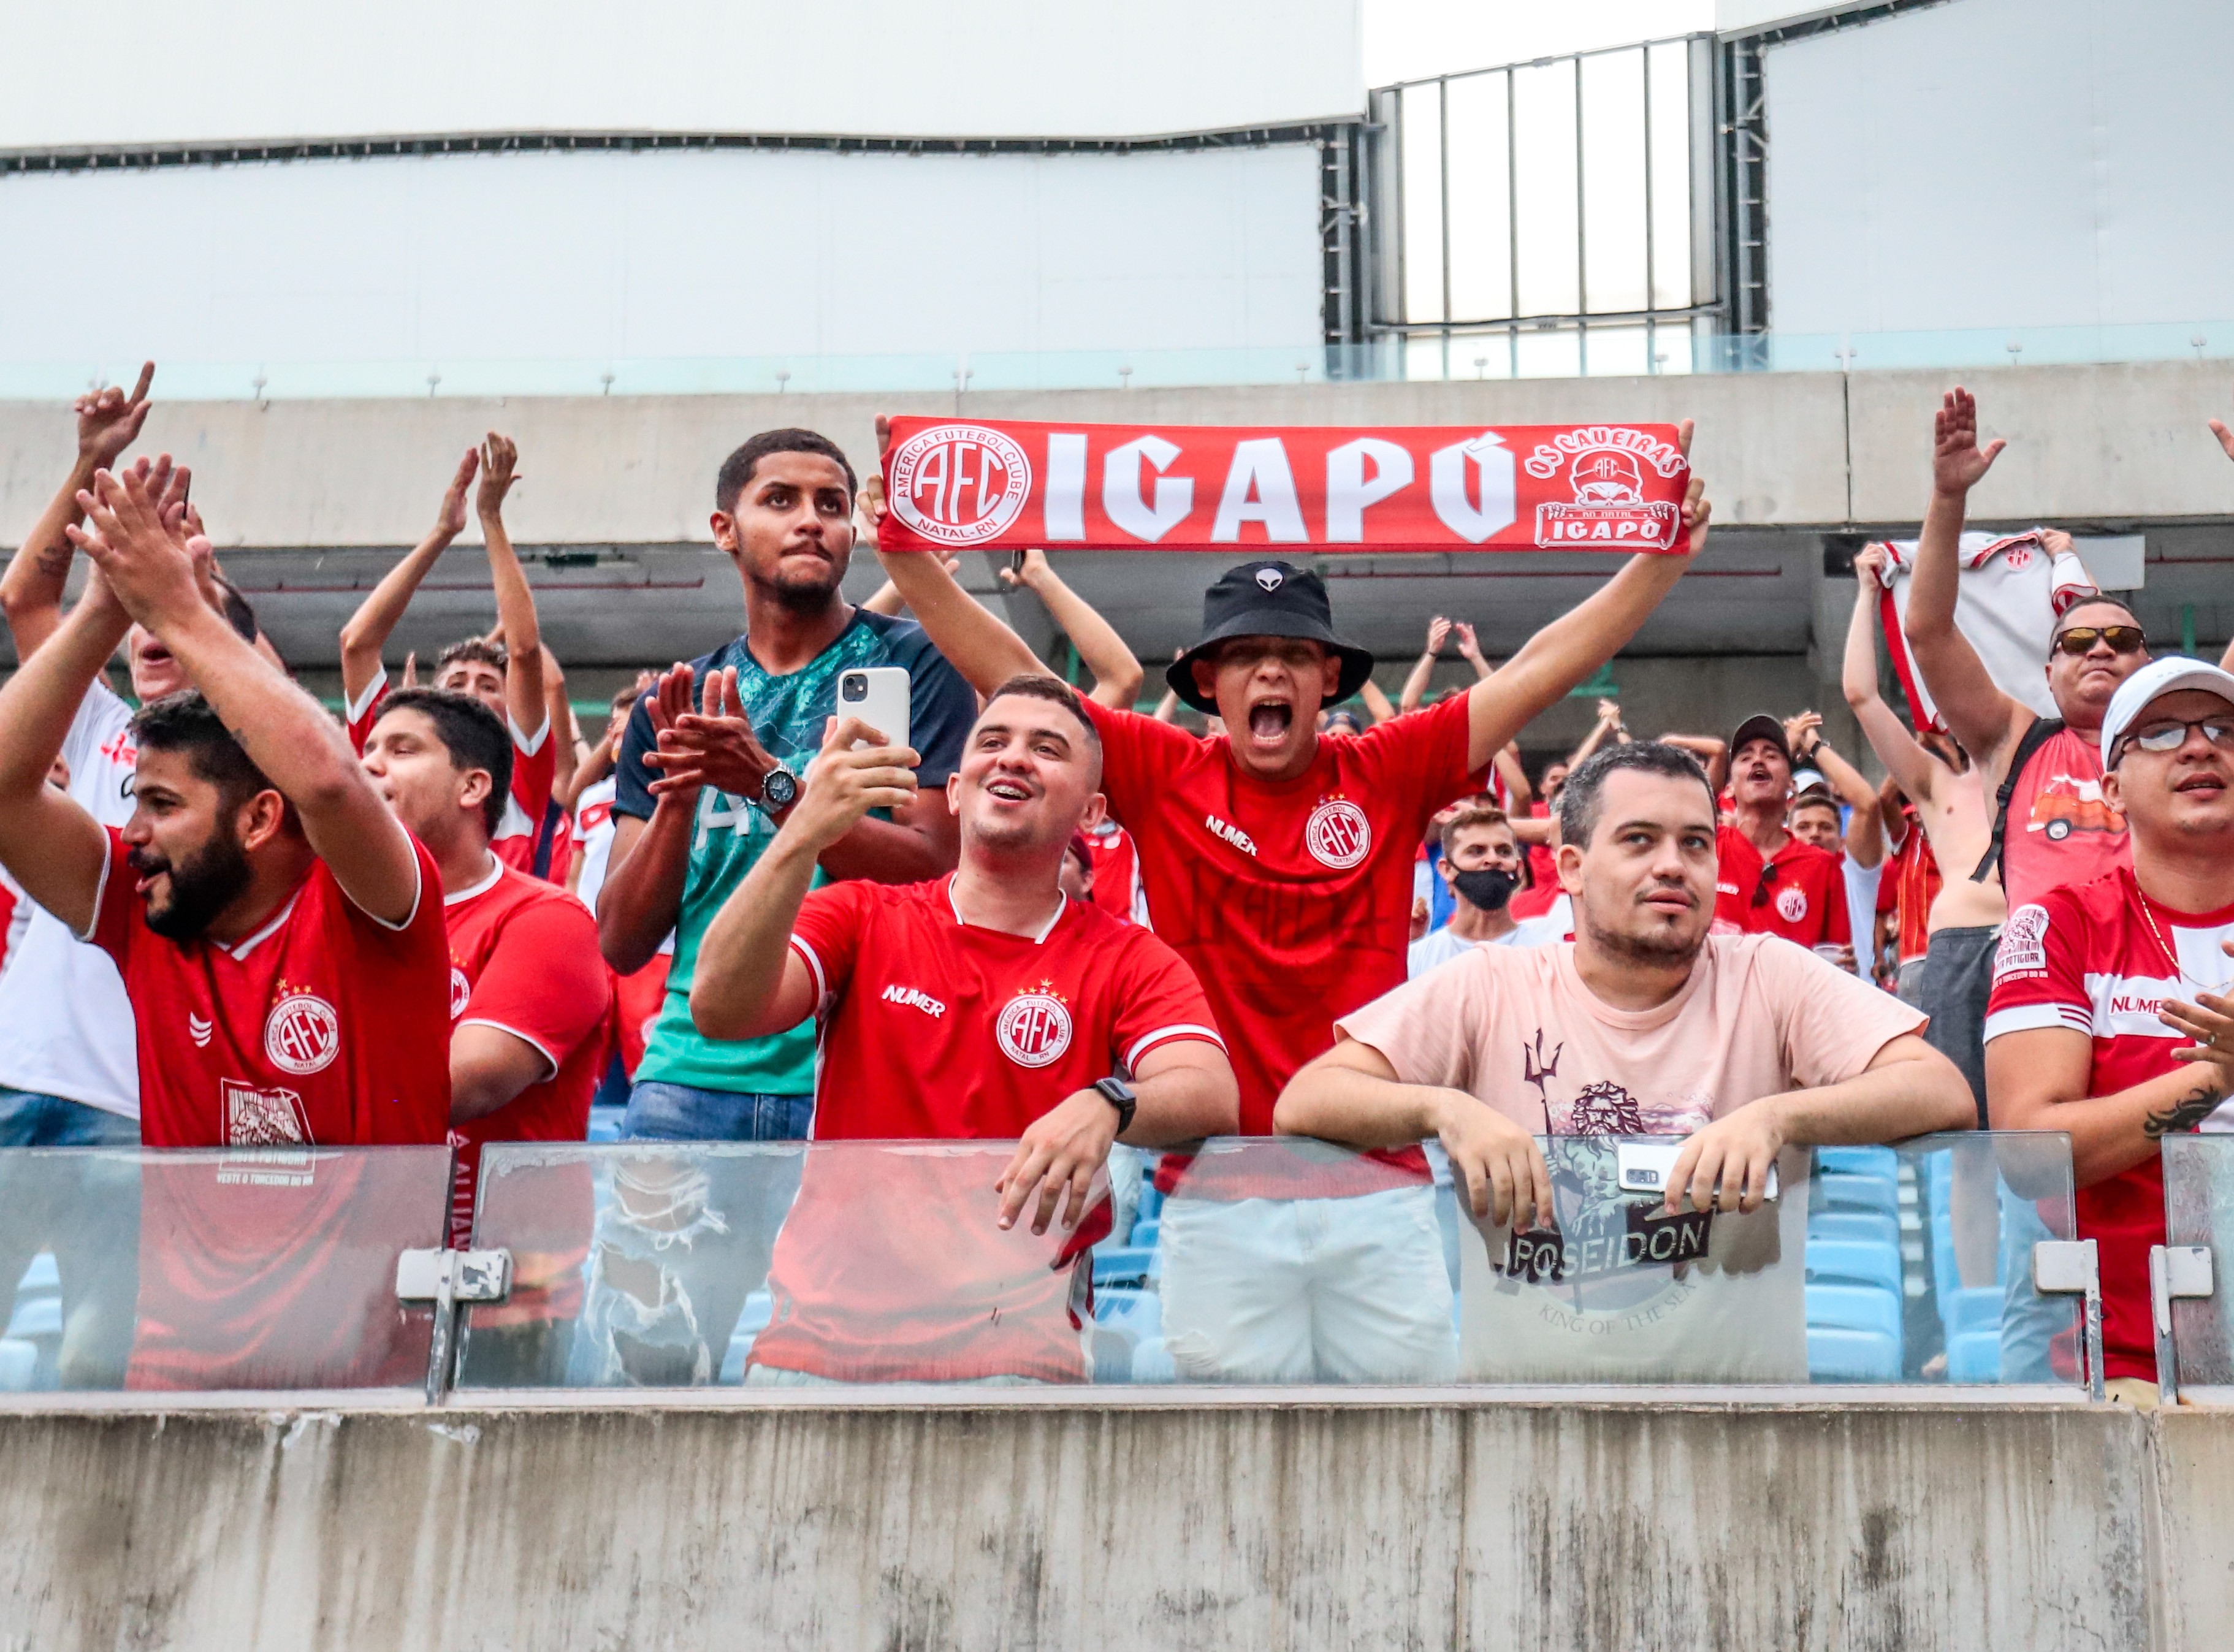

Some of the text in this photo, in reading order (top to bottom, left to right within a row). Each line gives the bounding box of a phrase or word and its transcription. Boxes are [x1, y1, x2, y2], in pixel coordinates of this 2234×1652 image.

[914, 442, 1004, 524] AFC
[935, 430, 1004, 452] FUTEBOL
[1004, 452, 1023, 501] CLUBE
[1043, 431, 1517, 544] IGAPÓ
[1553, 519, 1661, 540] IGAPÓ
[1319, 813, 1360, 856] AFC
[882, 984, 945, 1018] NUMER
[2111, 995, 2162, 1014] NUME
[280, 1011, 327, 1060] AFC
[1012, 1007, 1056, 1052] AFC
[1513, 1220, 1706, 1278] POSEIDON
[1539, 1304, 1584, 1333] KING
[1589, 1320, 1615, 1335] OF
[1622, 1304, 1665, 1331] THE
